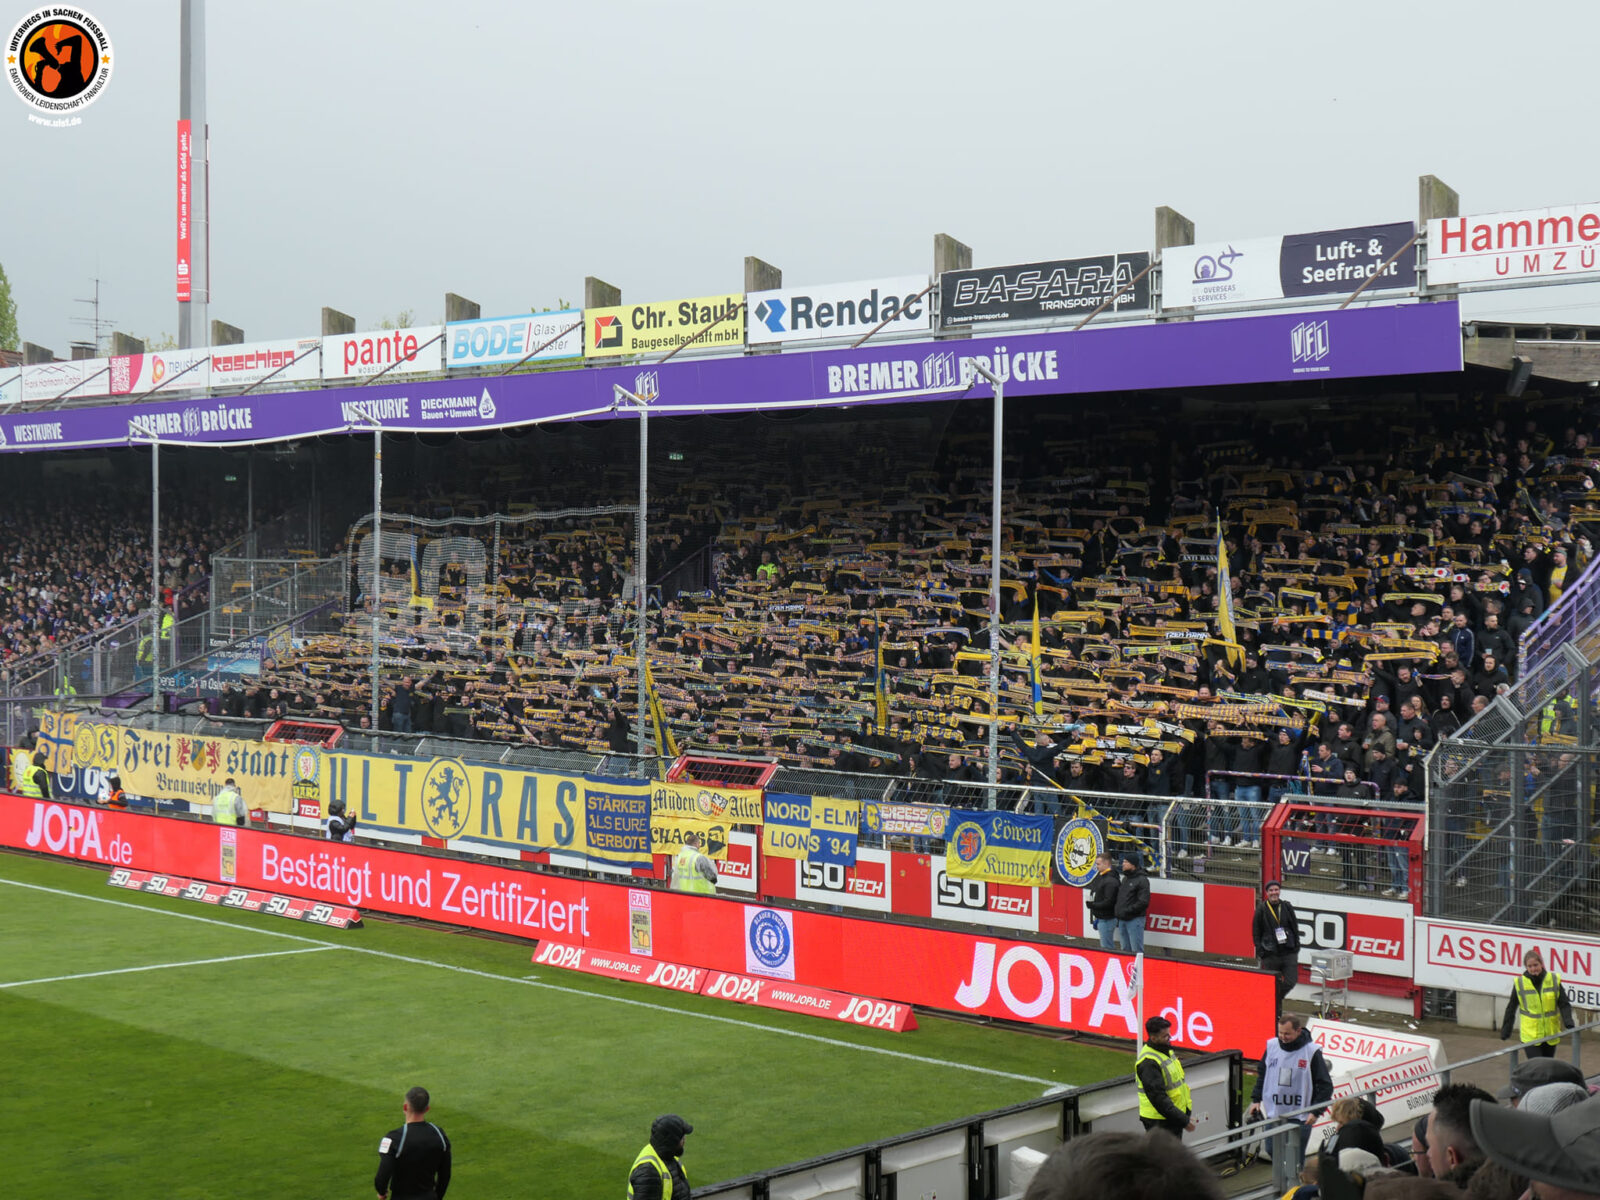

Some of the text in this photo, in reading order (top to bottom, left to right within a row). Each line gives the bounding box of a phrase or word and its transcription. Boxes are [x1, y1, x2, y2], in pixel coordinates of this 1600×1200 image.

[180, 203, 187, 216] um
[1316, 238, 1382, 262] Luft- &
[1302, 261, 1398, 284] Seefracht
[954, 262, 1134, 307] BASARA
[1203, 284, 1236, 294] OVERSEAS
[1040, 296, 1101, 311] TRANSPORT
[1197, 293, 1228, 302] SERVICES
[631, 297, 739, 331] Chr. Staub
[791, 288, 923, 331] Rendac
[452, 322, 526, 359] BODE
[533, 324, 551, 337] Glas
[631, 328, 739, 349] Baugesellschaft mbH
[344, 330, 418, 375] pante
[828, 360, 920, 394] BREMER
[959, 346, 1059, 385] BRÜCKE
[201, 404, 252, 432] BRÜCKE
[340, 396, 477, 422] WESTKURVE DIECKMANN
[421, 411, 442, 420] Bauen
[450, 408, 478, 418] Umwelt
[13, 422, 63, 442] WESTKURVE
[124, 728, 171, 773] Frei
[300, 803, 320, 816] TECH
[588, 796, 646, 813] STÄRKER
[652, 788, 761, 818] Müden Aller
[589, 814, 647, 832] ALS EURE
[766, 801, 811, 822] NORD
[823, 807, 858, 828] ELM
[650, 826, 706, 848] CHAOS
[991, 816, 1042, 843] Löwen
[588, 832, 648, 850] VERBOTE
[771, 830, 819, 853] LIONS
[718, 861, 750, 876] TECH
[1282, 849, 1310, 868] W7
[802, 860, 884, 894] SO TECH
[262, 844, 590, 938] Bestätigt und Zertifiziert
[631, 894, 649, 907] RAL
[938, 873, 1030, 913] SO TECH
[1148, 913, 1194, 932] TECH
[1350, 936, 1401, 956] TECH
[537, 943, 696, 990] JOPA WWW.JOPA.DE JOPA
[707, 973, 897, 1028] JOPA WWW.JOPA.DE JOPA
[1567, 985, 1600, 1006] ÖBEL
[1406, 1090, 1437, 1110] BÜROMÖ
